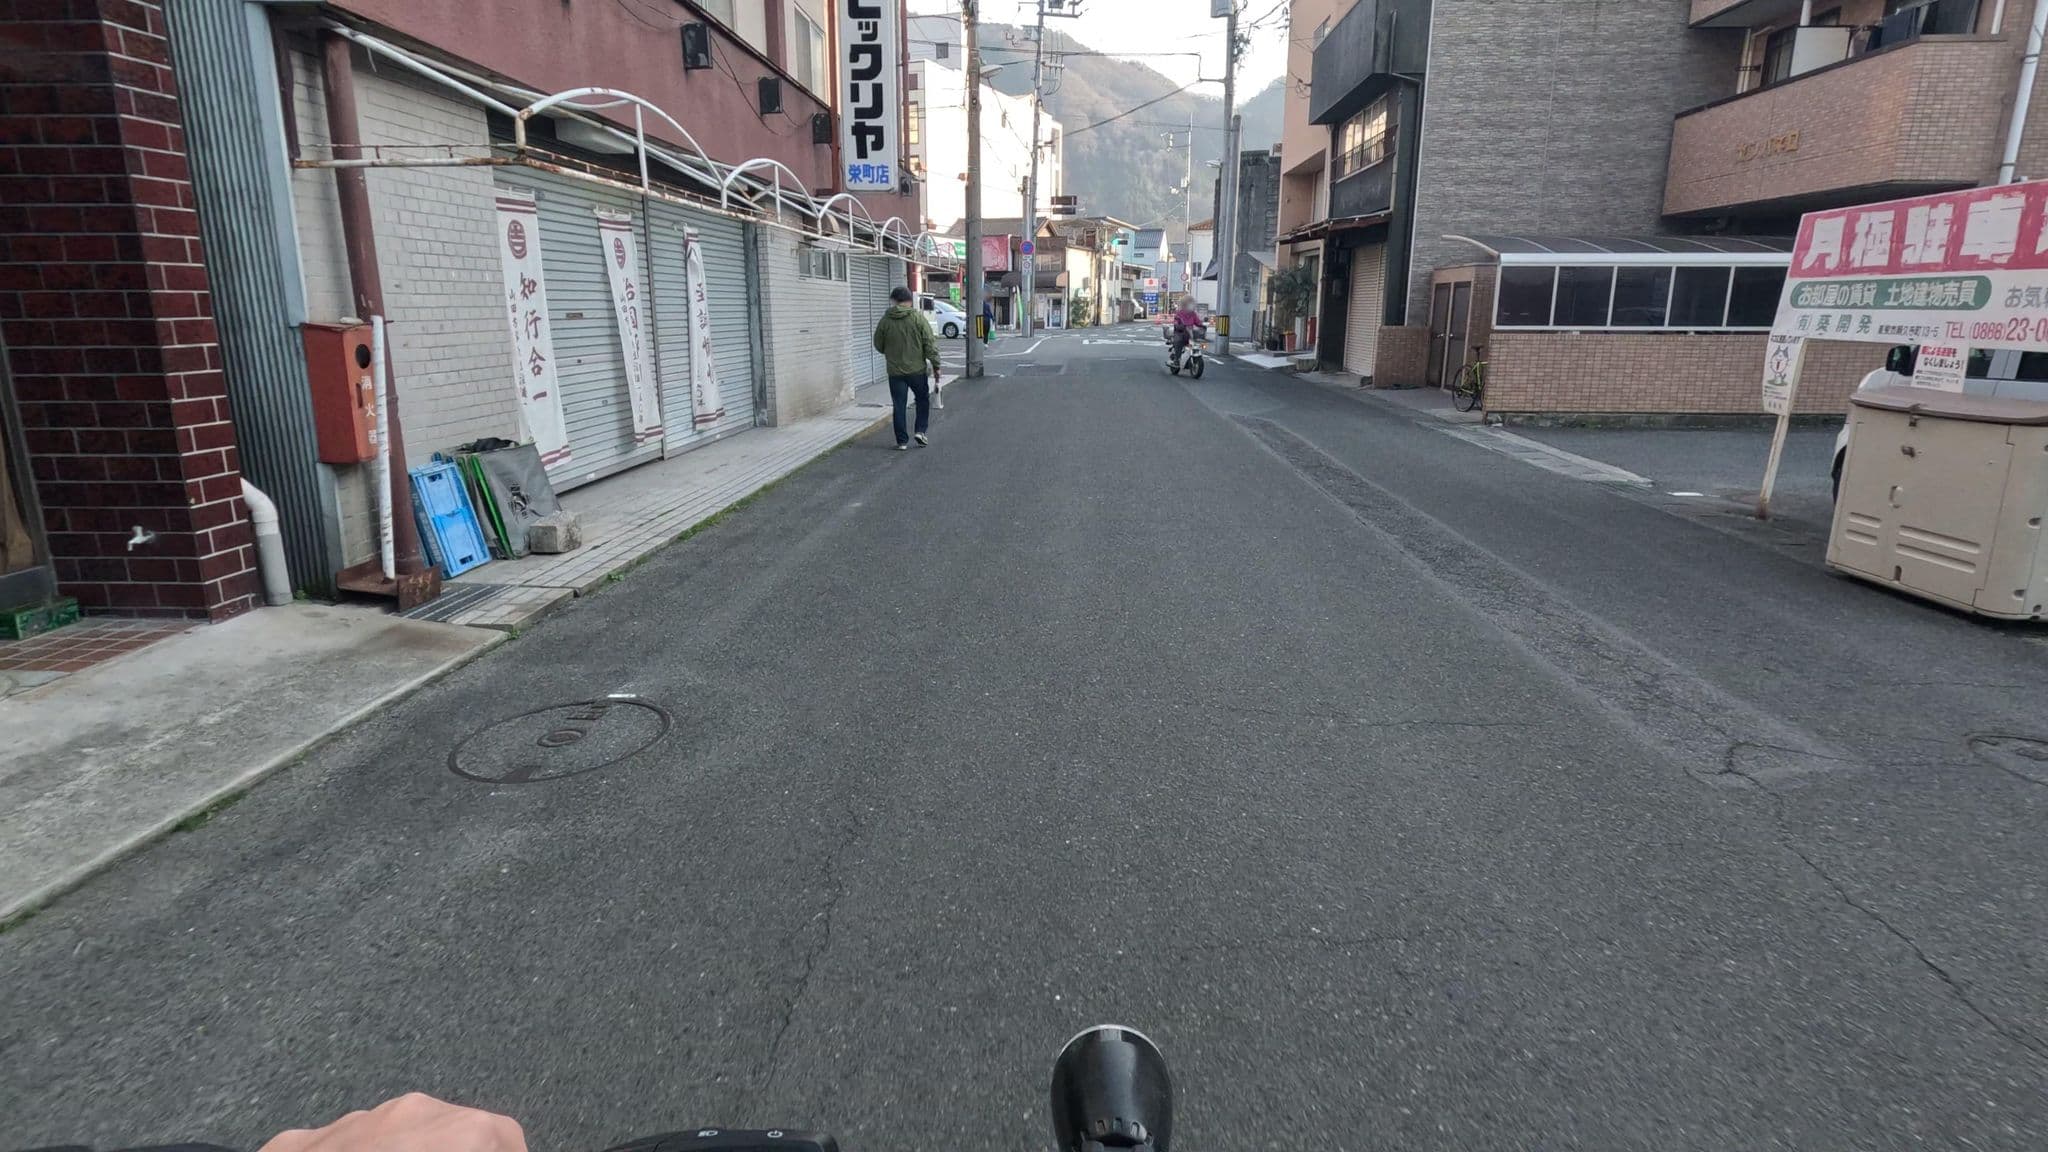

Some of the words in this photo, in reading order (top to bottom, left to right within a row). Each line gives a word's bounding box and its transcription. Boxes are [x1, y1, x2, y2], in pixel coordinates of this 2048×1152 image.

[848, 164, 889, 184] 栄町店
[1801, 193, 2048, 270] 月極駐車
[1798, 283, 1877, 306] お部屋の賃貸
[1884, 279, 1977, 307] 土地建物売買
[2005, 286, 2048, 308] お気
[520, 272, 548, 401] 知行合一
[1945, 321, 1966, 339] TEL
